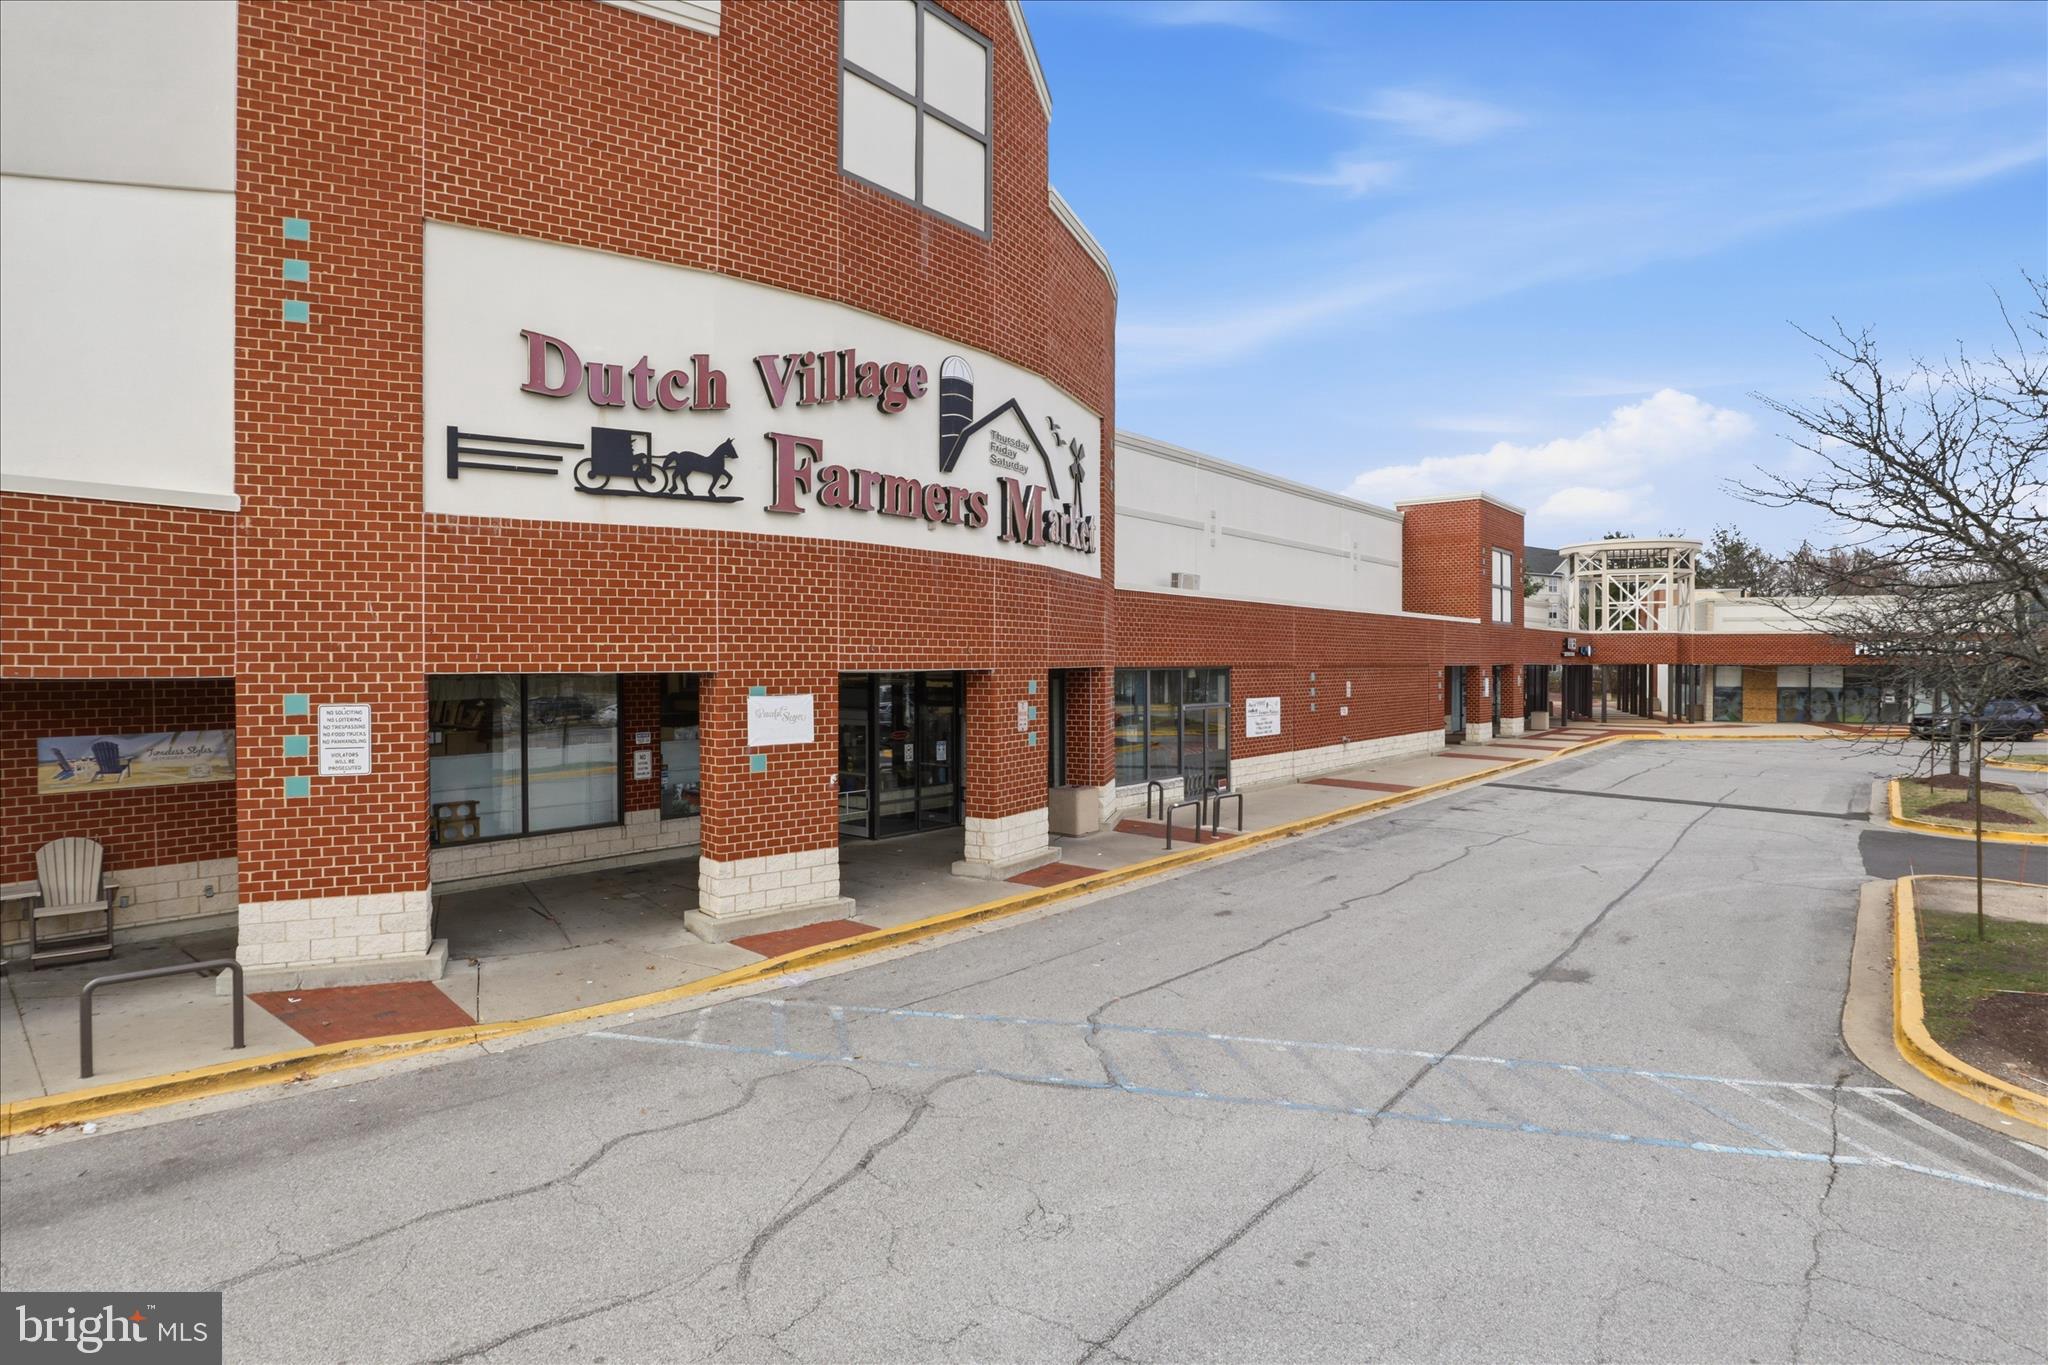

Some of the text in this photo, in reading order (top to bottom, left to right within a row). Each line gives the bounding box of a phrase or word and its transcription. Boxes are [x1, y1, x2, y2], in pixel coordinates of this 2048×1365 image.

[519, 328, 929, 414] Dutch Village
[990, 429, 1030, 452] Thursday
[990, 441, 1018, 459] Friday
[990, 454, 1029, 475] Saturday
[764, 432, 1097, 554] Farmers Market
[186, 744, 213, 757] Styles
